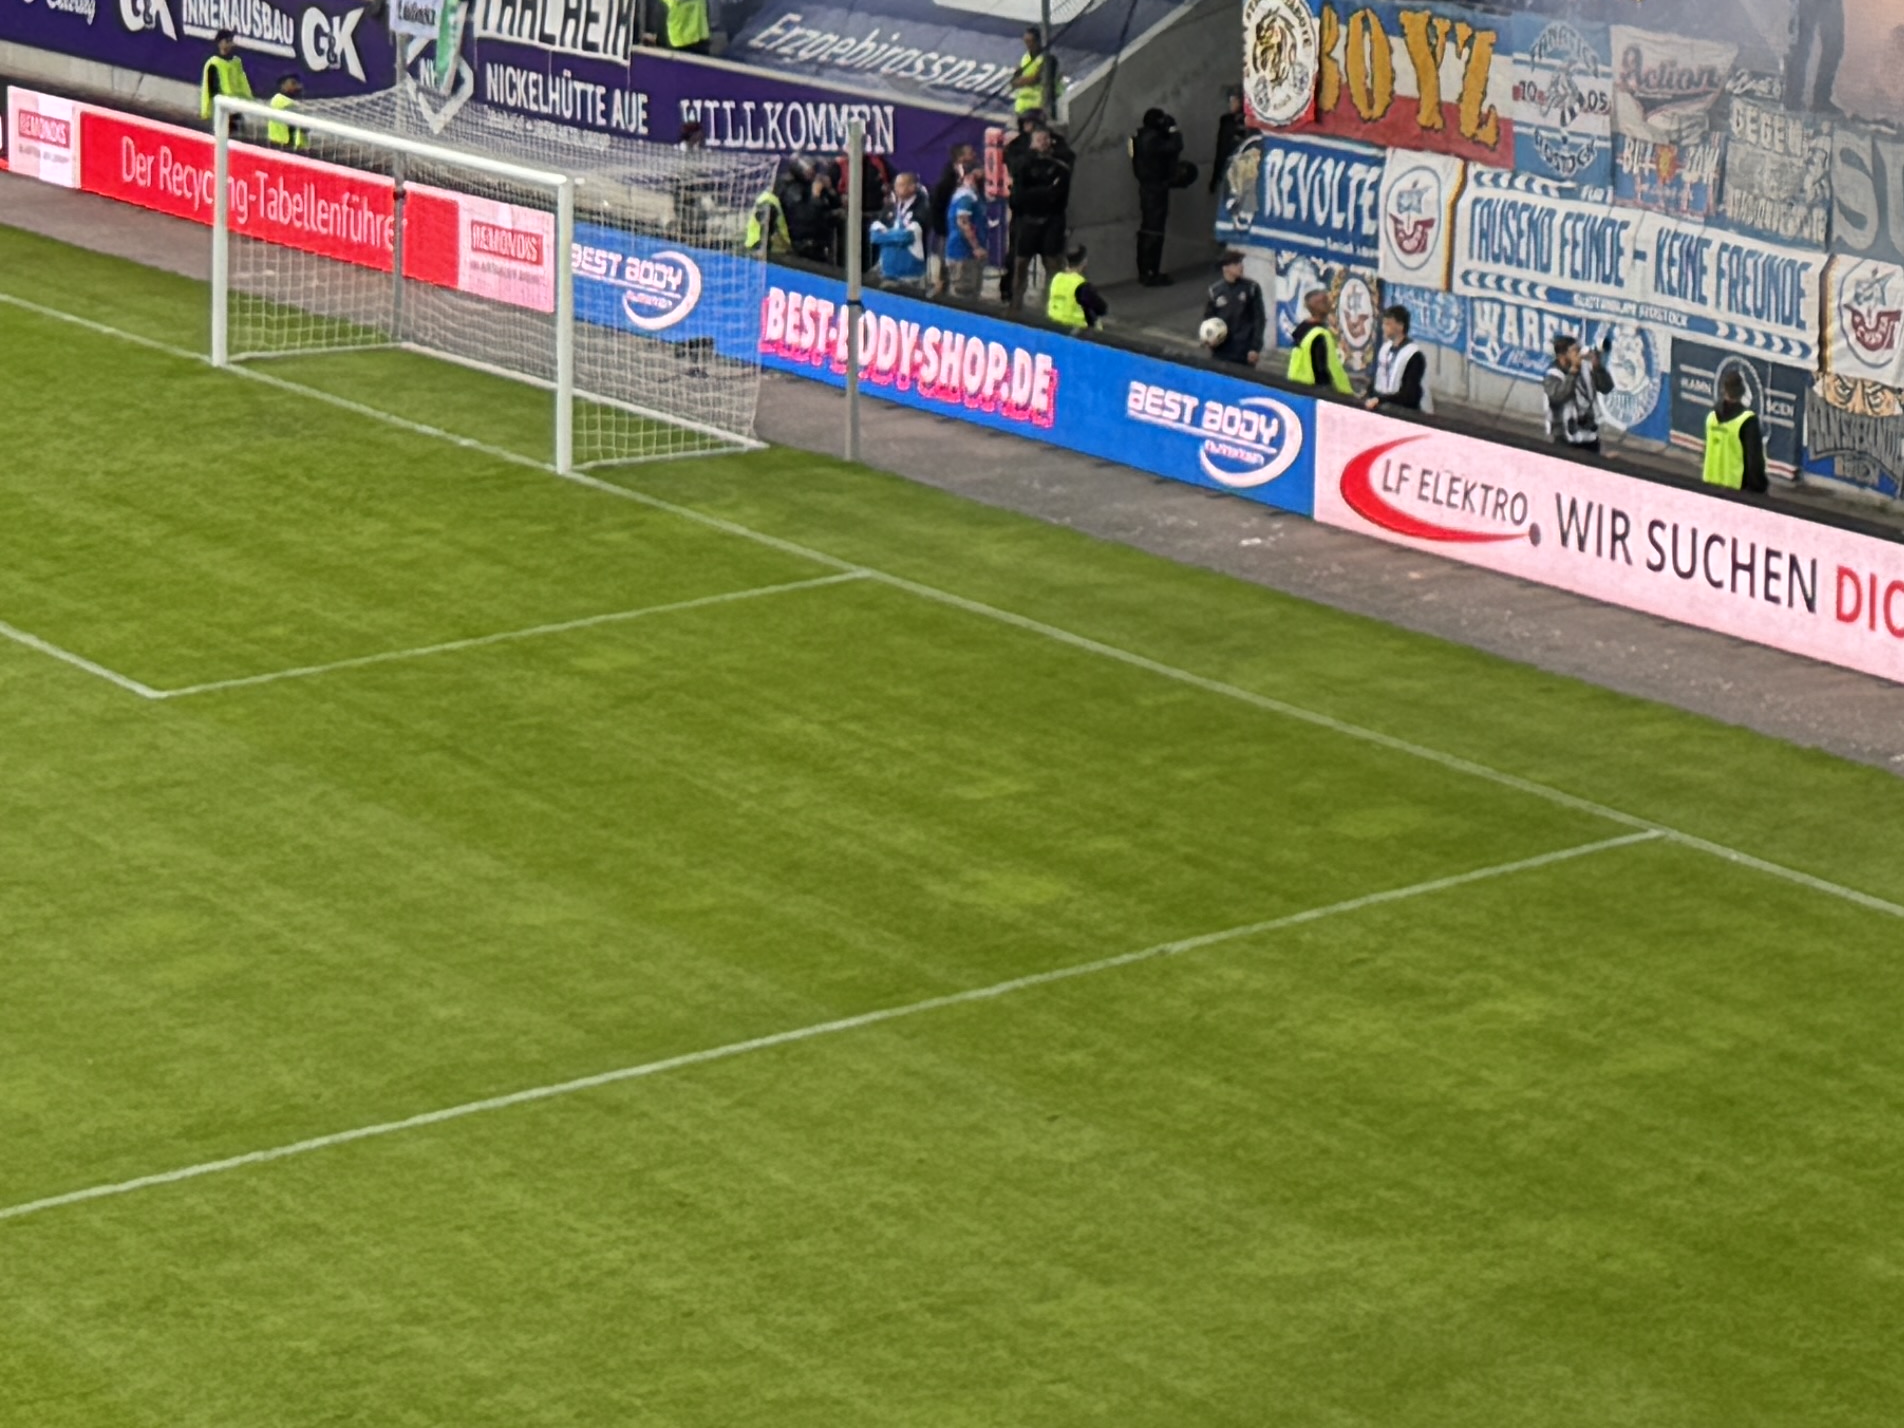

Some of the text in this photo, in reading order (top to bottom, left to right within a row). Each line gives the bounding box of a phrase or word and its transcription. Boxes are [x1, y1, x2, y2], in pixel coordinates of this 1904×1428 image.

[485, 60, 607, 128] NICKELHÜTTE
[611, 87, 649, 135] AUE
[1318, 4, 1499, 151] BOYZ
[121, 135, 155, 188] Der
[1263, 147, 1382, 236] REVOLTE
[1127, 380, 1279, 445] BEST BODY
[1380, 459, 1411, 496] LF
[1417, 469, 1528, 526] ELEKTRO
[1554, 492, 1633, 566] WIR
[1646, 519, 1818, 614] SUCHEN
